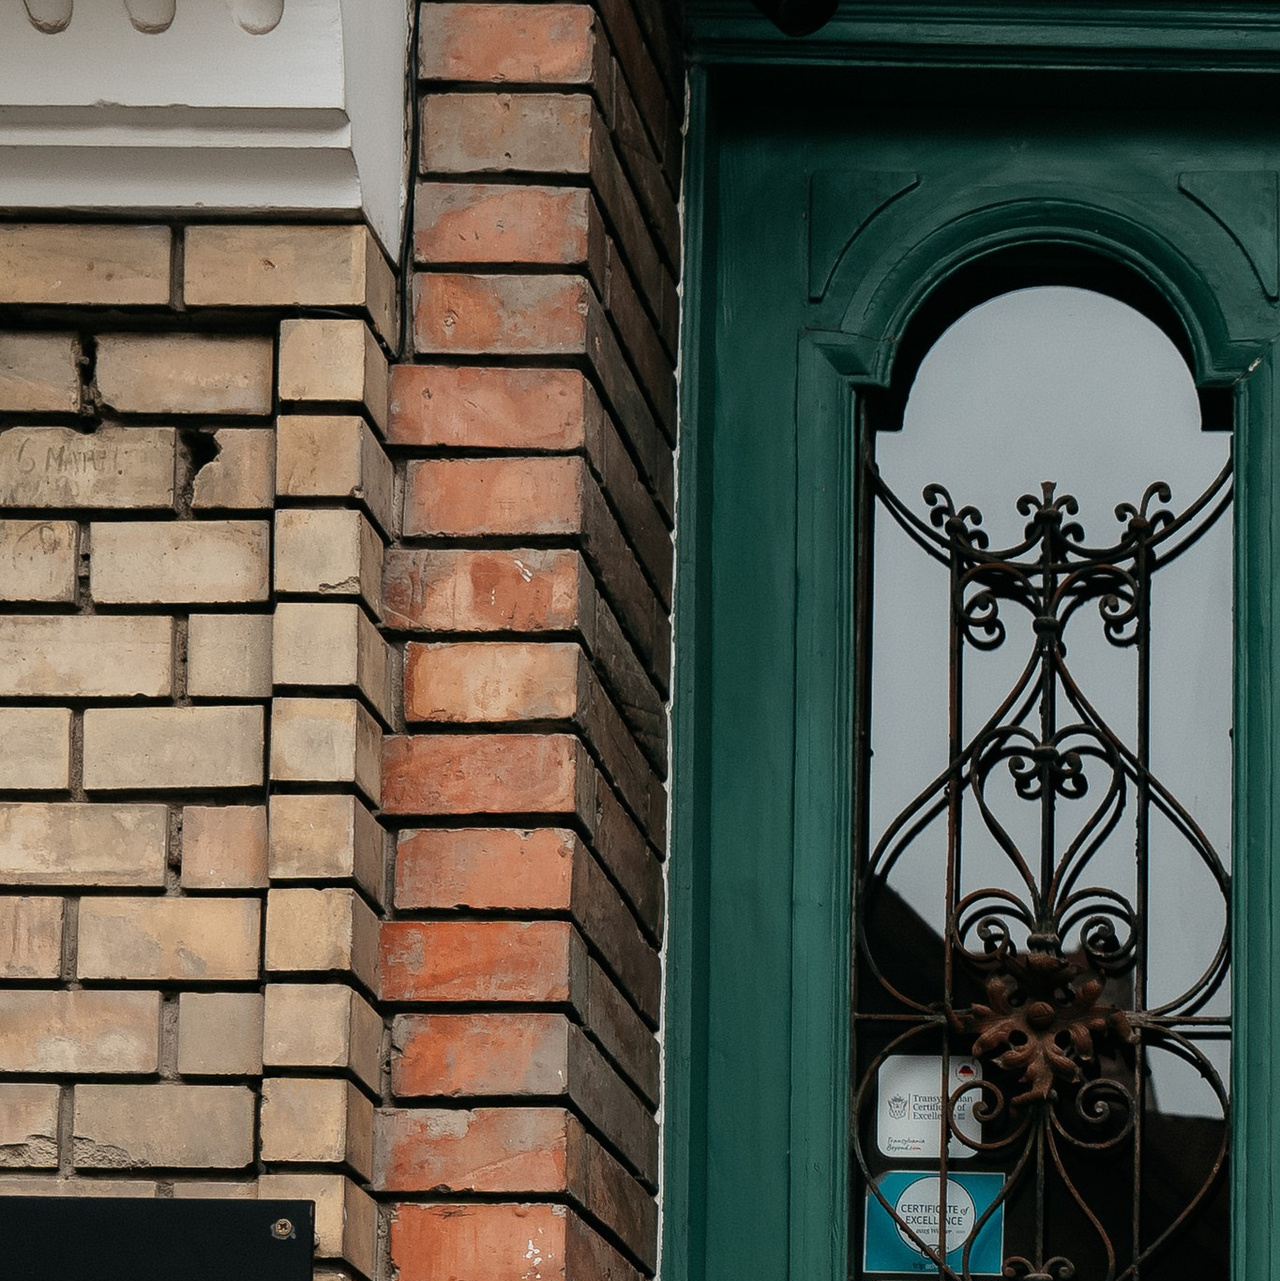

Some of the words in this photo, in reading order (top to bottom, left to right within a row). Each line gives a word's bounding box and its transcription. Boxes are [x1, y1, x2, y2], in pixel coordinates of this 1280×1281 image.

[957, 1103, 966, 1111] of
[900, 1204, 958, 1214] CERTIFICTE
[960, 1206, 970, 1215] of
[905, 1216, 963, 1225] EXCELLNCE
